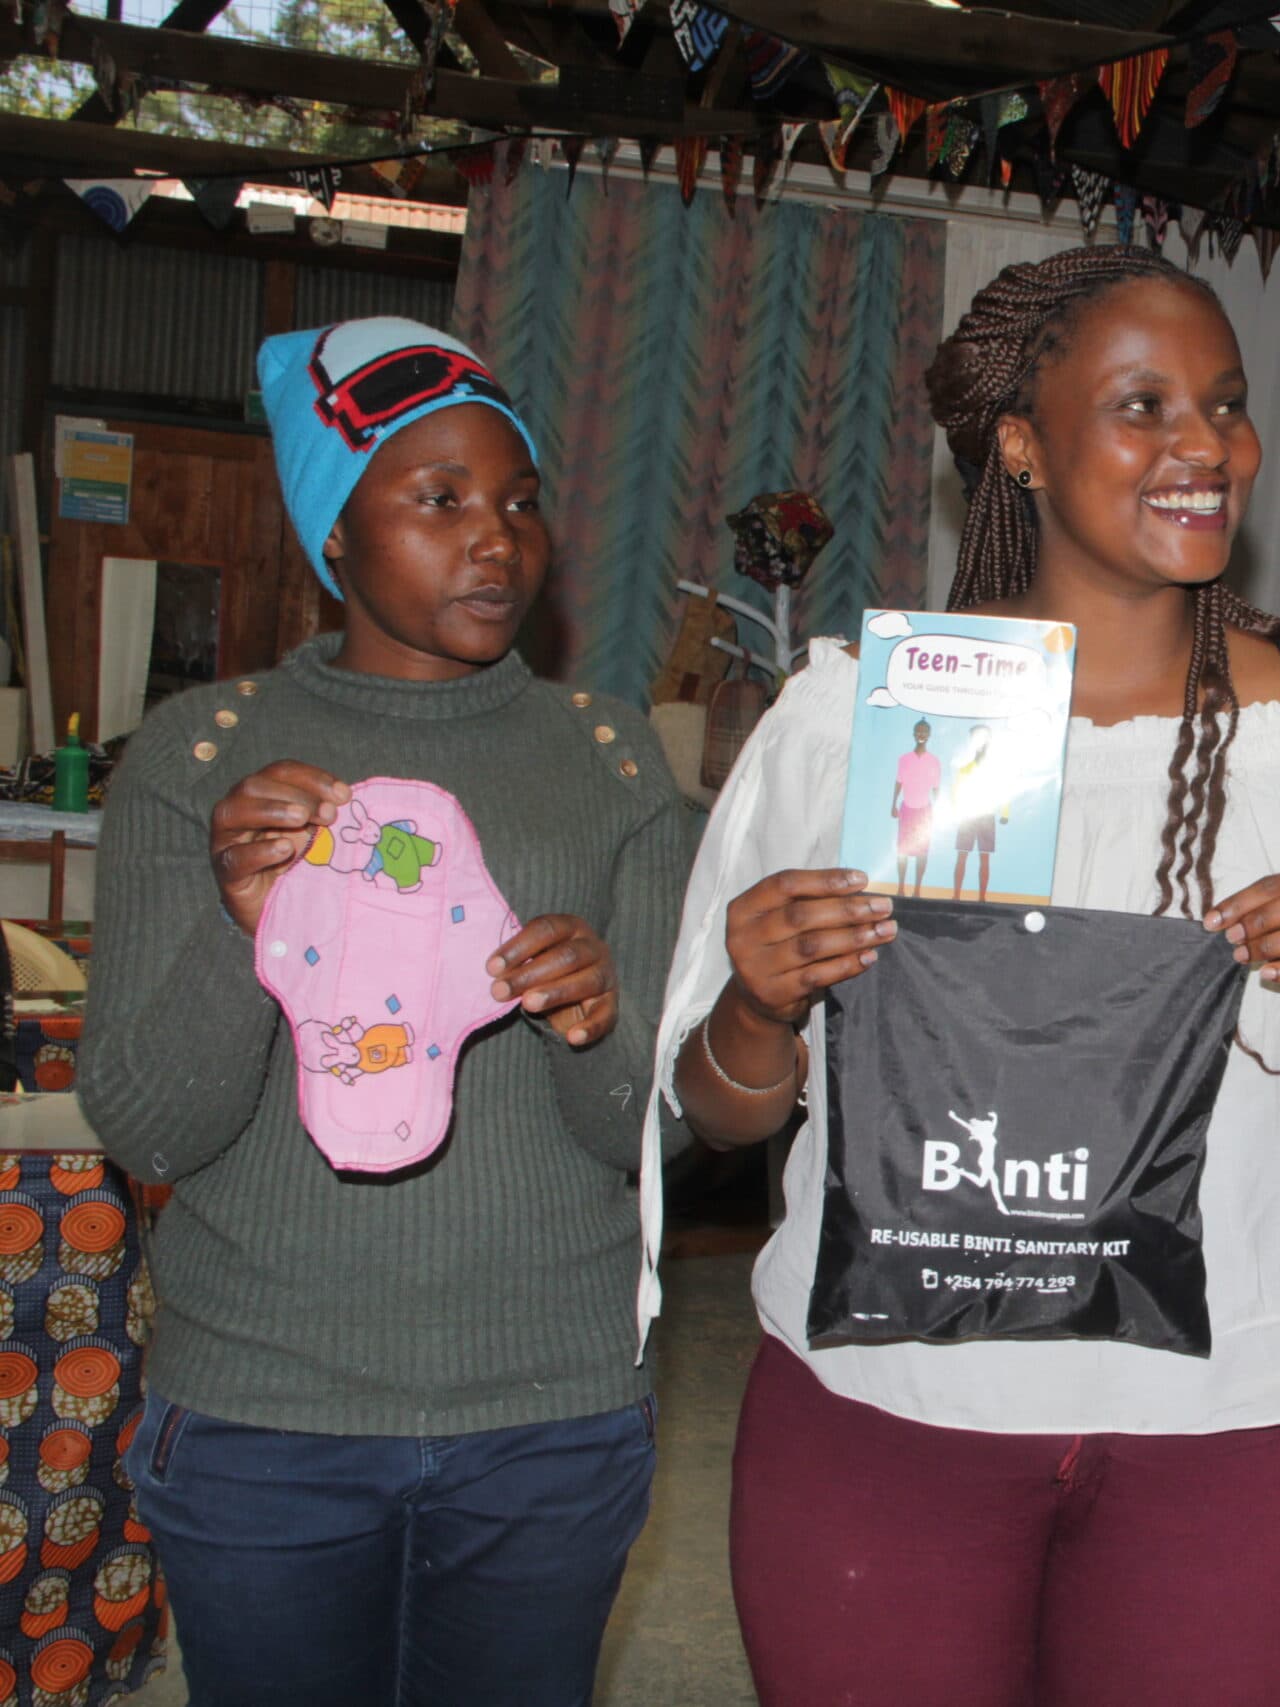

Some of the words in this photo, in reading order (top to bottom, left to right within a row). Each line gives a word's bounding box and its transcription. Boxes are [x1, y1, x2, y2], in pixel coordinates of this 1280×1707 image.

[905, 646, 1028, 677] Teen-Time
[902, 682, 923, 691] YOUR
[925, 684, 949, 693] GUIDE
[921, 1138, 1090, 1202] Binti
[870, 1228, 960, 1248] RE-USABLE
[963, 1234, 1012, 1253] BINTI
[1014, 1239, 1099, 1256] SANITARY
[1102, 1239, 1131, 1257] KIT
[943, 1274, 982, 1290] +254
[983, 1276, 1014, 1290] 794
[1015, 1276, 1046, 1289] 774
[1047, 1275, 1076, 1288] 293
